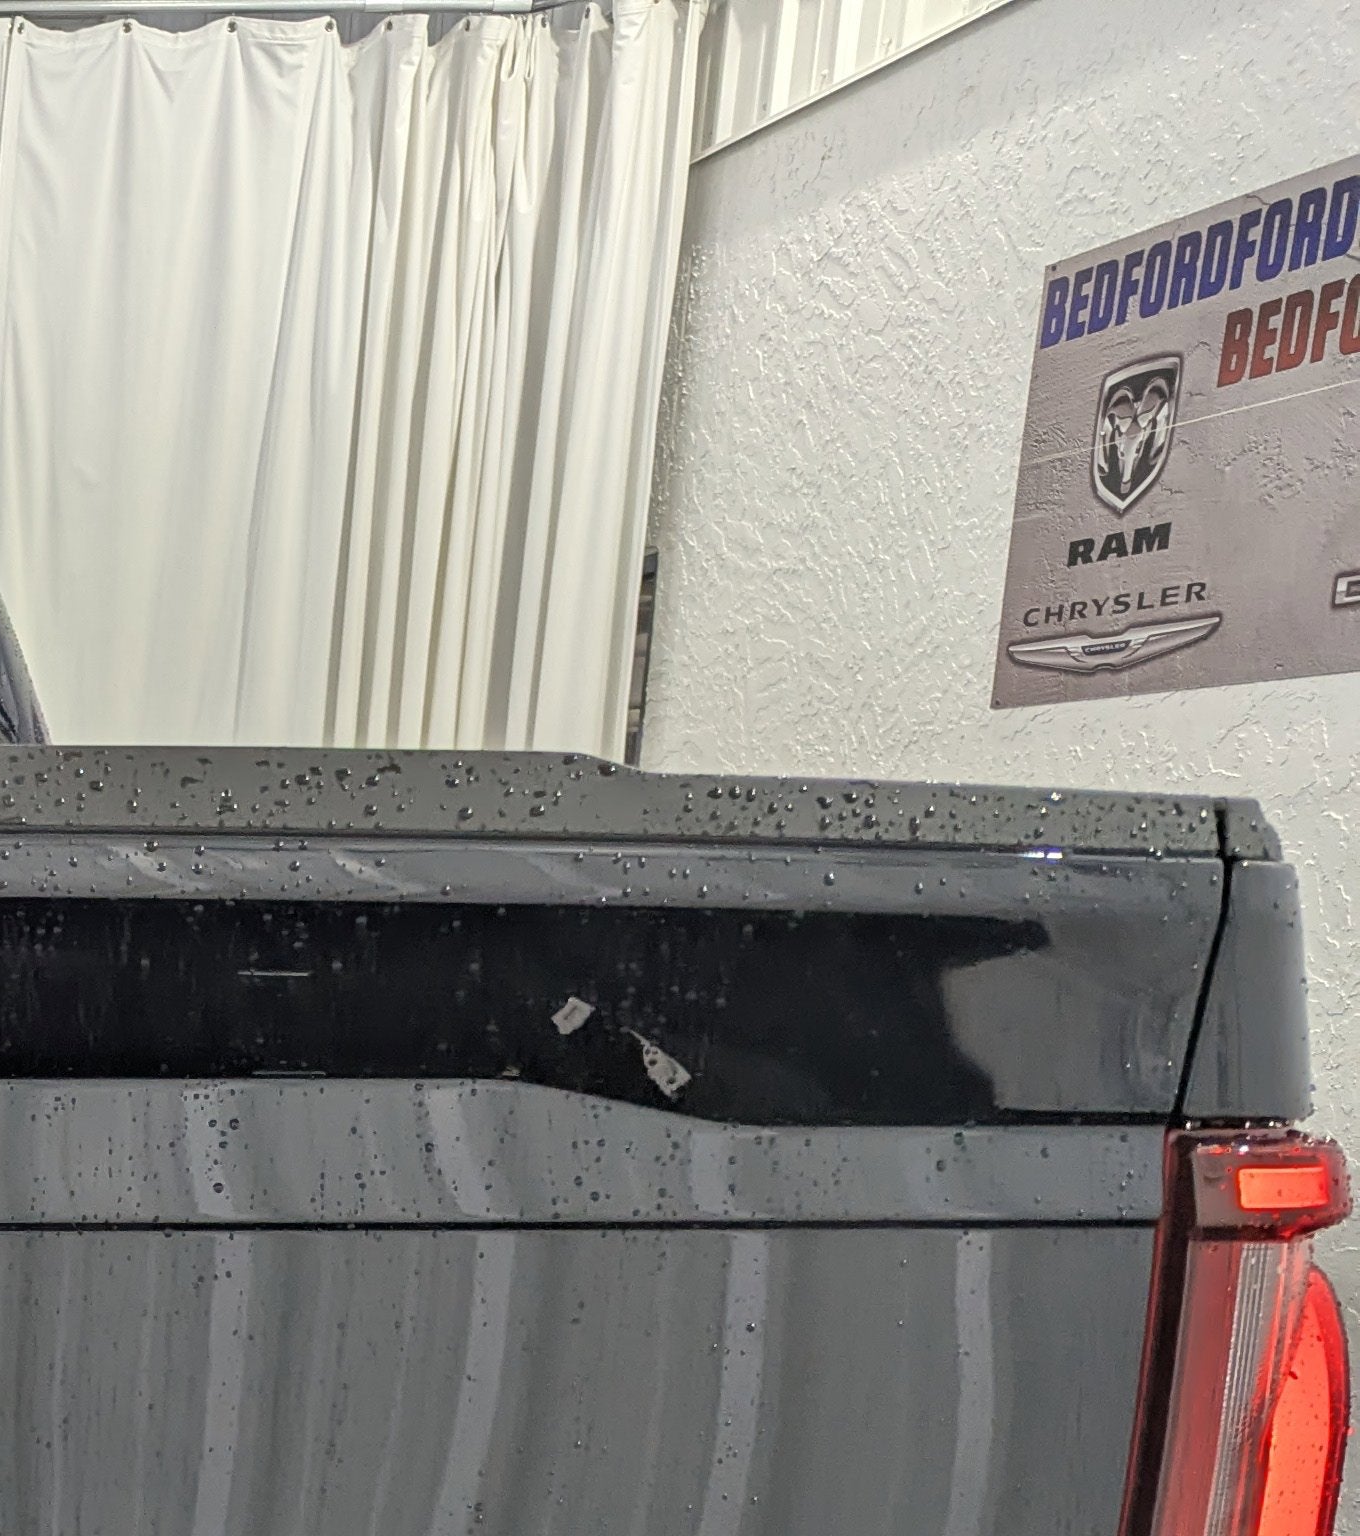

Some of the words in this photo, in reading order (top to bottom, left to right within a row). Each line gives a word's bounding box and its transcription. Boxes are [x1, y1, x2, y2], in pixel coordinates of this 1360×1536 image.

[1039, 174, 1360, 350] BEDFORDFORD
[1067, 522, 1172, 568] RAM
[1023, 582, 1207, 627] CHRYSLER
